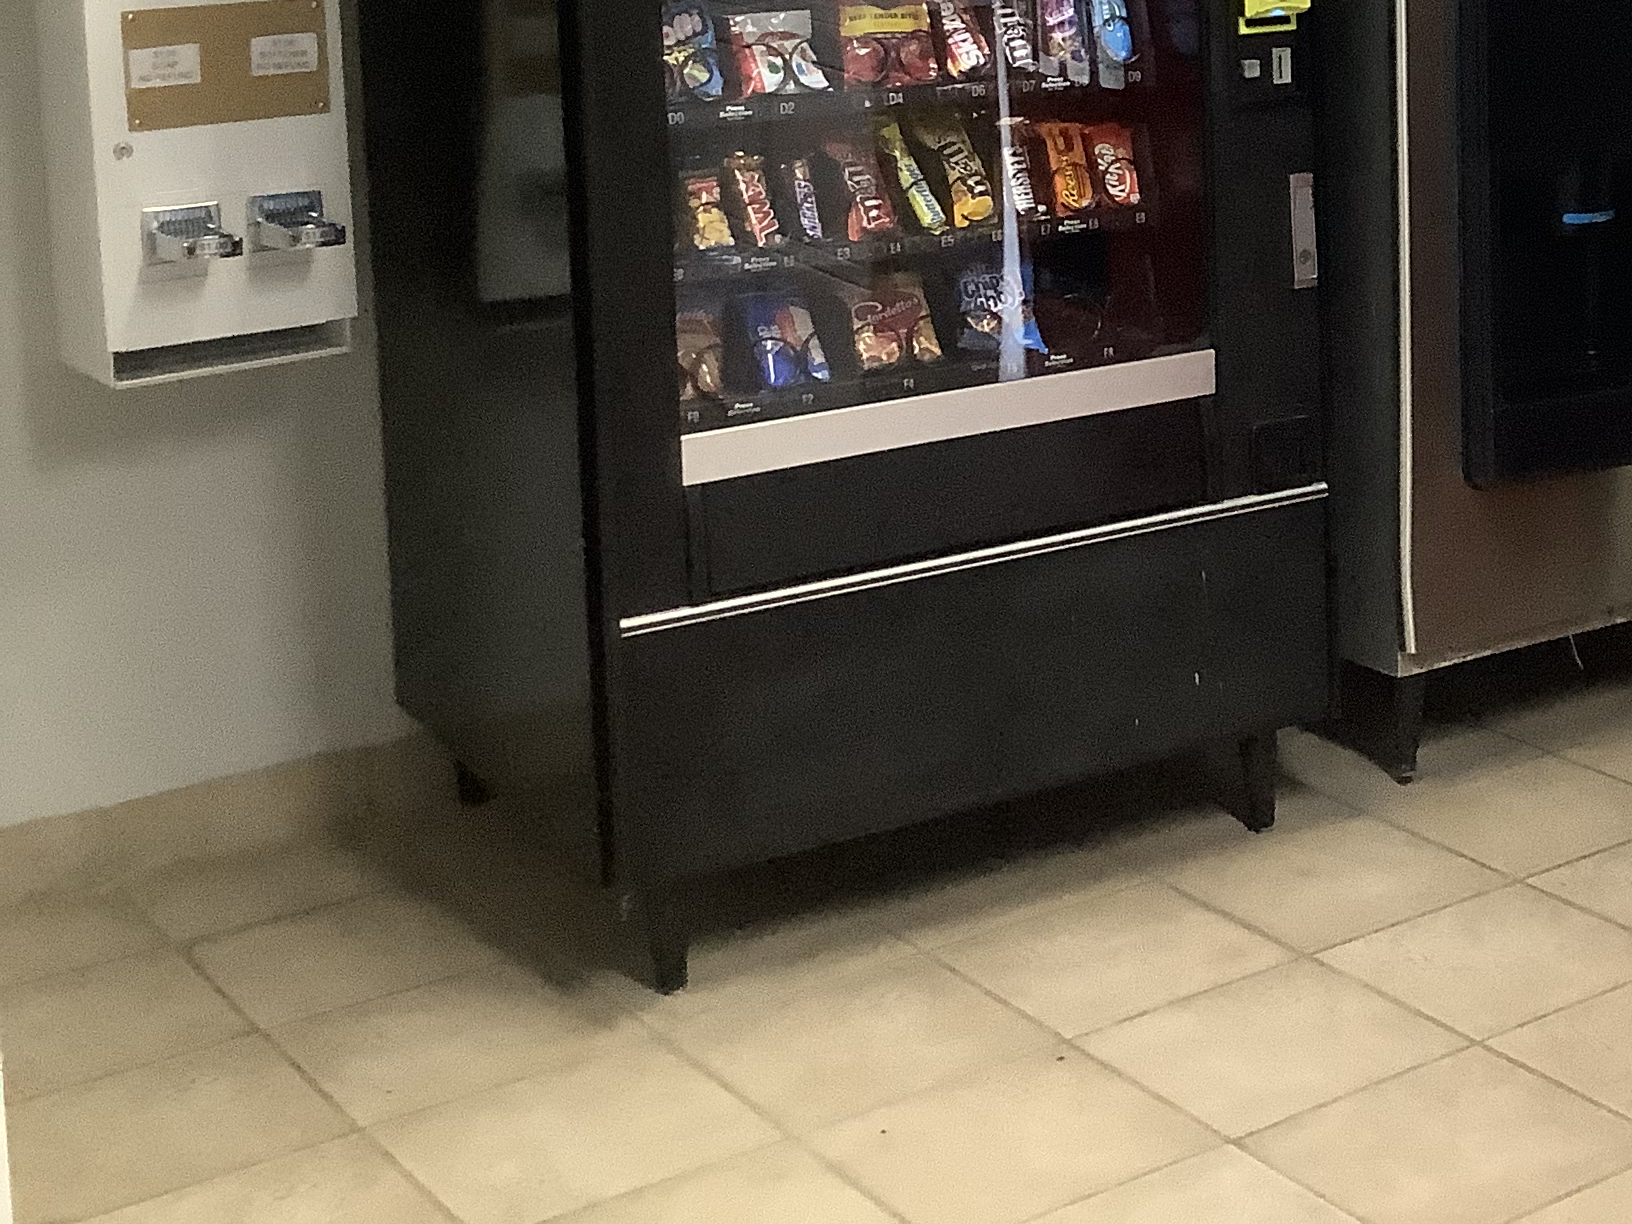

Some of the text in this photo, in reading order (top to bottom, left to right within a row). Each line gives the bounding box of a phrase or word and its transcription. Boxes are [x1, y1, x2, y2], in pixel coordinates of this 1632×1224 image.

[971, 85, 986, 97] D6
[1022, 79, 1036, 92] D7
[889, 92, 904, 104] D4
[780, 102, 795, 114] D2
[668, 112, 685, 124] D0
